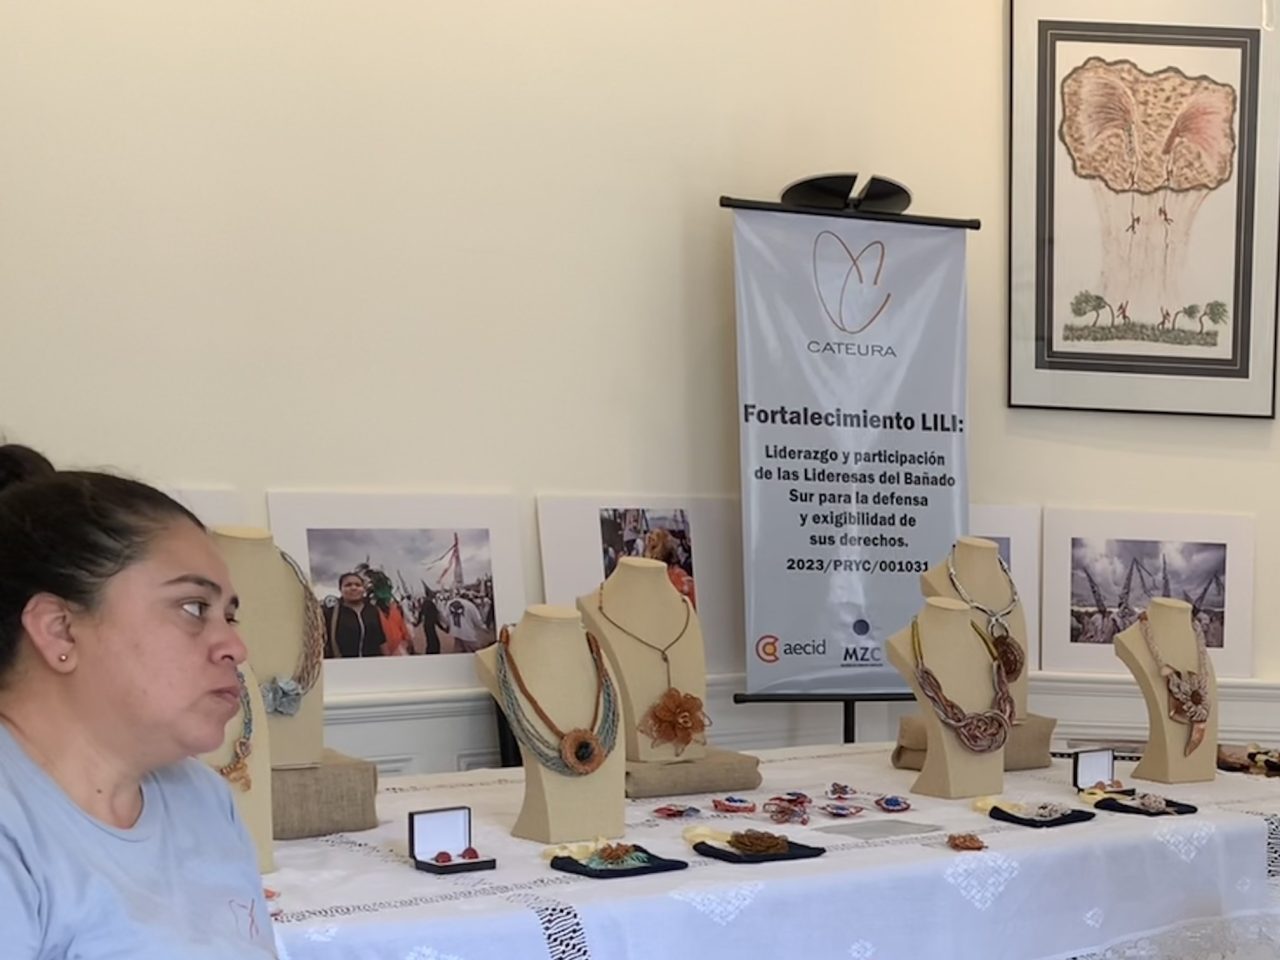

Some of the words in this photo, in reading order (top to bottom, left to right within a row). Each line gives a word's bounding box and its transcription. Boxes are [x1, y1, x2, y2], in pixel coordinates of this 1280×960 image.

[806, 340, 897, 358] CATEURA
[743, 403, 915, 431] Fortalecimiento
[921, 412, 964, 433] LILI:
[764, 444, 839, 465] Liderazgo
[842, 450, 851, 465] y
[853, 449, 945, 467] participación
[754, 466, 773, 480] de
[777, 466, 800, 481] las
[803, 467, 875, 484] Lideresas
[879, 471, 900, 485] del
[904, 471, 956, 487] Bañado
[788, 488, 815, 503] Sur
[818, 492, 852, 506] para
[855, 491, 869, 505] la
[872, 491, 929, 507] defensa
[799, 512, 808, 527] y
[811, 510, 896, 528] exigibilidad
[899, 513, 917, 527] de
[808, 533, 836, 546] sus
[839, 532, 909, 548] derechos.
[786, 558, 929, 575] 2023/PRYC/001031
[783, 639, 826, 656] aecid
[843, 646, 882, 662] MZC
